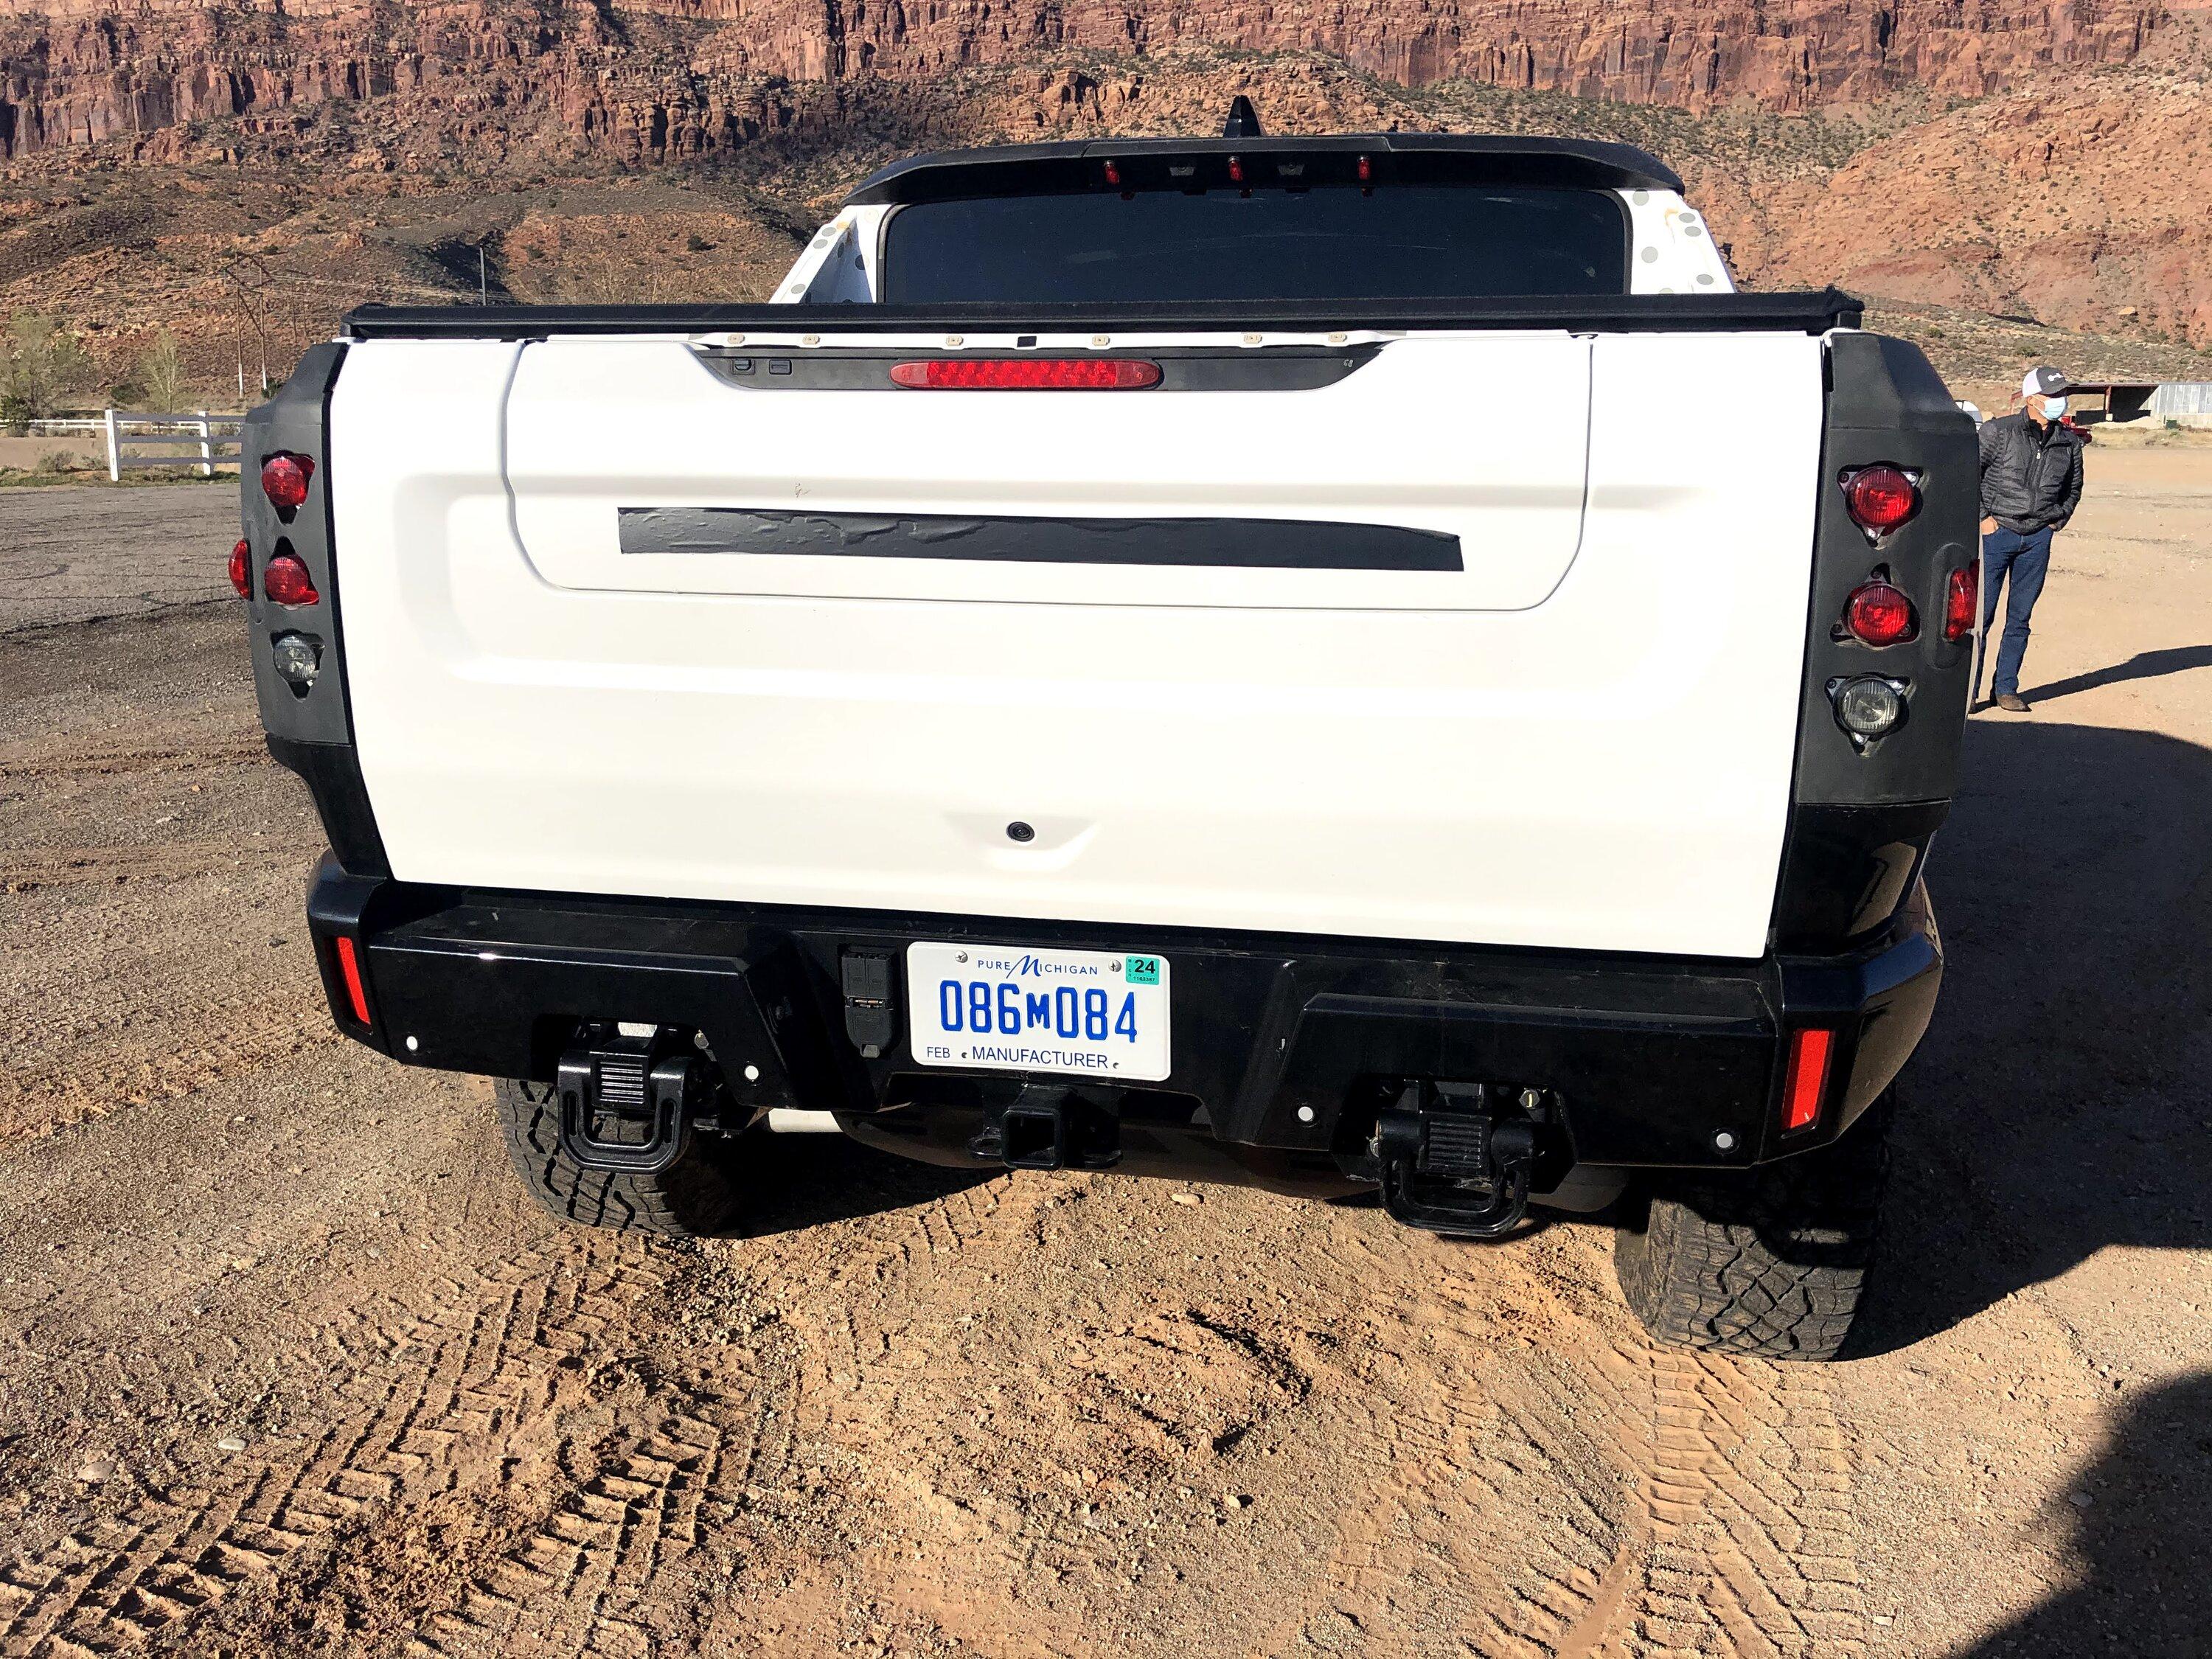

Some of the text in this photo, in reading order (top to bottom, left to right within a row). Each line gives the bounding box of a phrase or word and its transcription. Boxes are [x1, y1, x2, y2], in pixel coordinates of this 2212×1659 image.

[978, 955, 1098, 978] PURE MICHIGAN
[1134, 959, 1155, 974] 24
[939, 980, 1137, 1043] 086M084
[927, 1046, 1108, 1068] FEB MANUFACTURER
